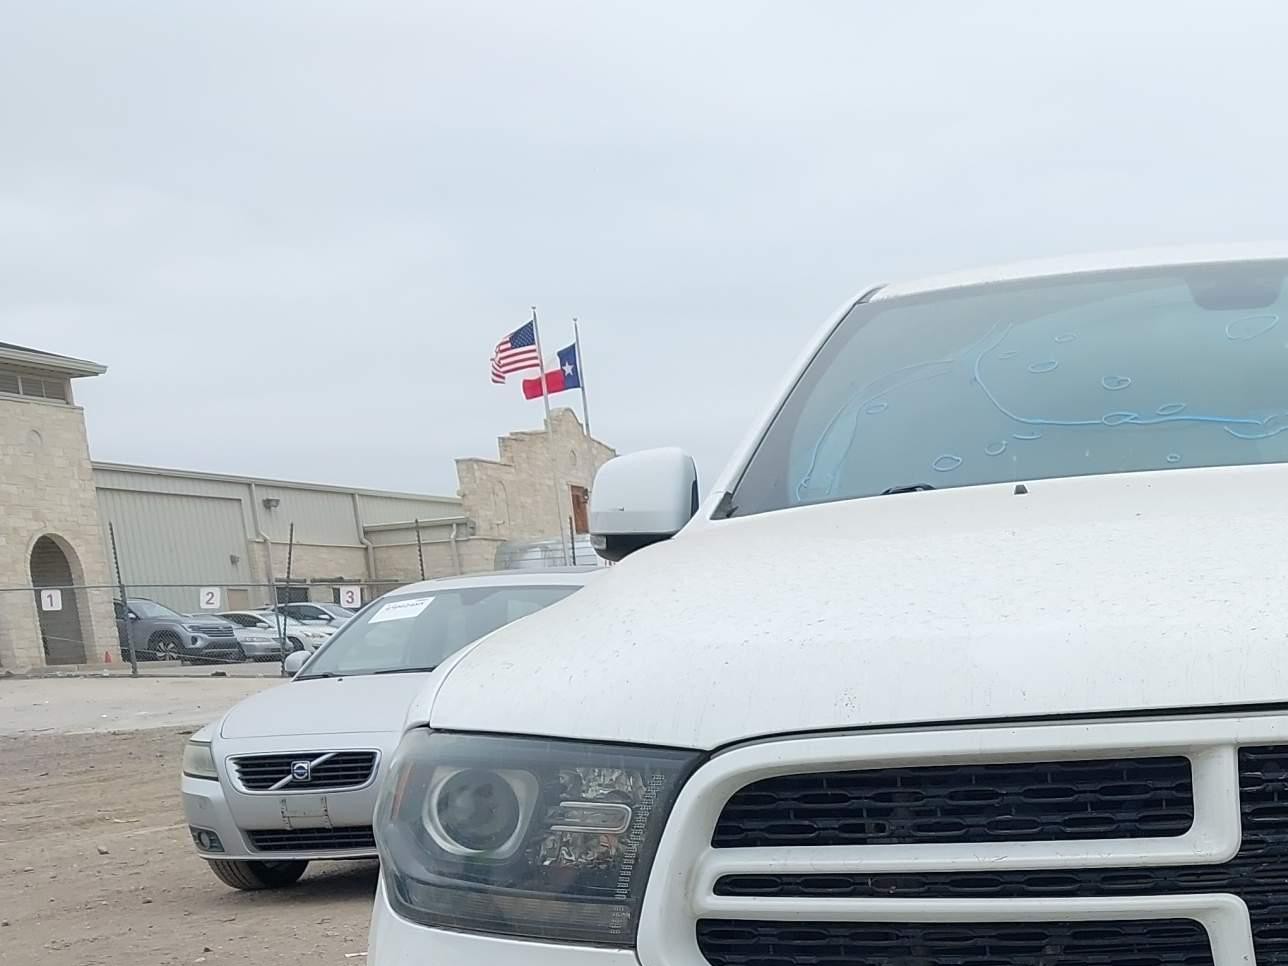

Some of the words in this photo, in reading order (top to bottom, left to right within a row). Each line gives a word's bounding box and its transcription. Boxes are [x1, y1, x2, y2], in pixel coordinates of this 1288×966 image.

[46, 593, 56, 608] 1
[205, 591, 215, 605] 2
[345, 590, 355, 604] 3
